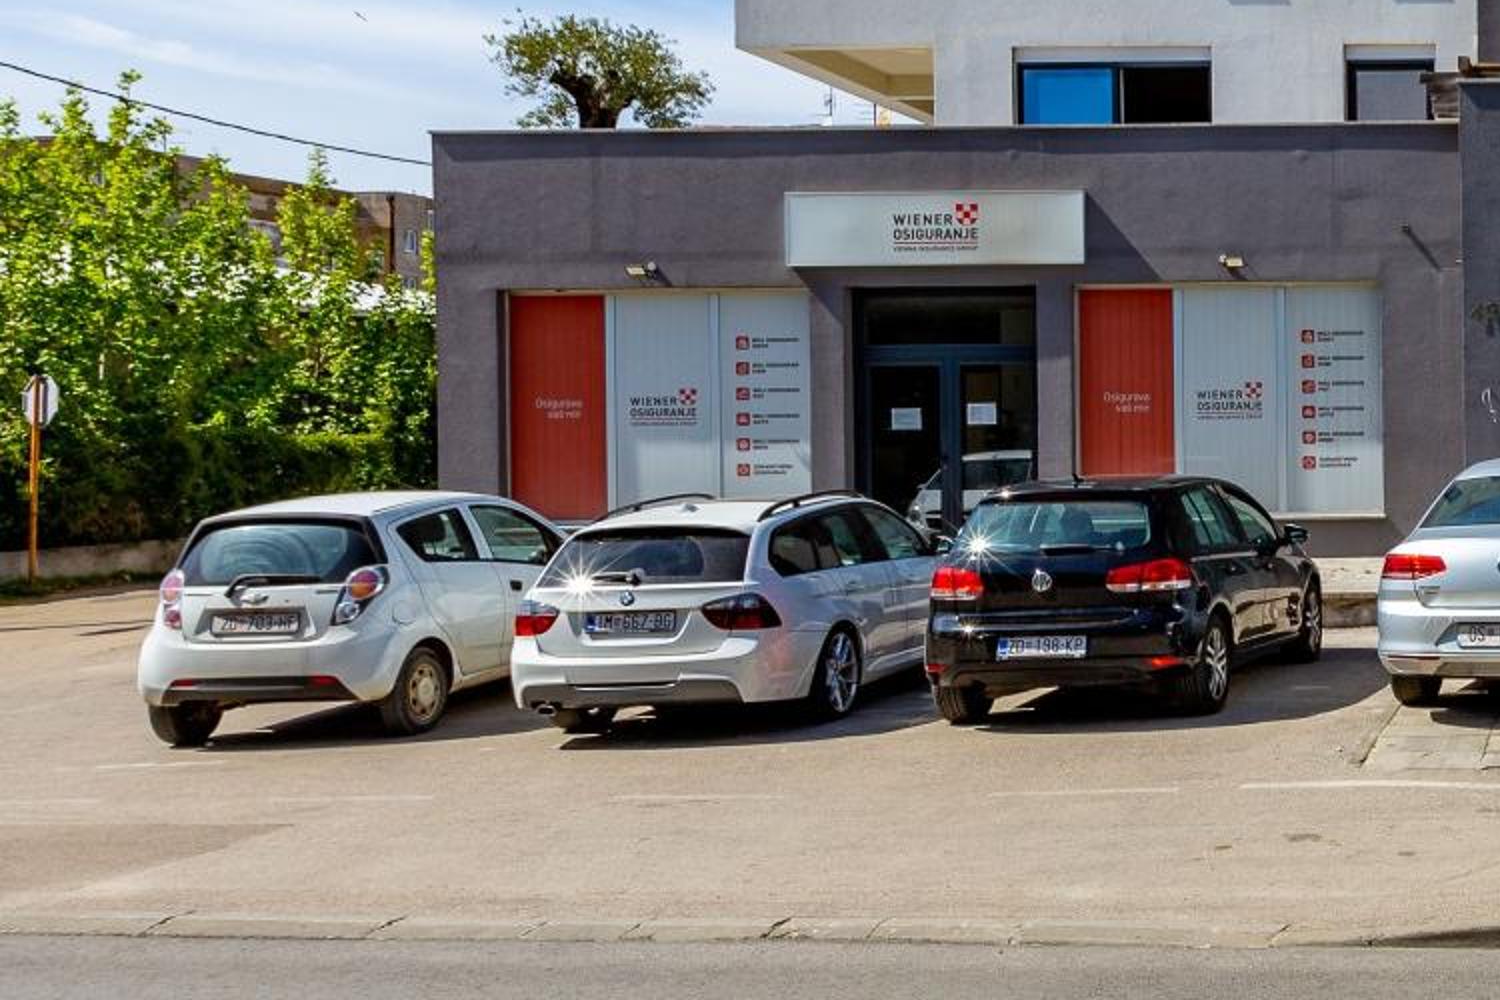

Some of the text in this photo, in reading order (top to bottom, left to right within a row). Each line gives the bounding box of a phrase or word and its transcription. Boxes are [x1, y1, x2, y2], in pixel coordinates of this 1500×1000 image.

[893, 213, 953, 226] WIENER
[893, 228, 979, 240] OSIGURANJE
[1197, 390, 1242, 399] WIENER
[630, 397, 677, 406] WIENER
[1197, 401, 1262, 410] OSIGURANJE
[630, 408, 697, 417] OSIGURANJE
